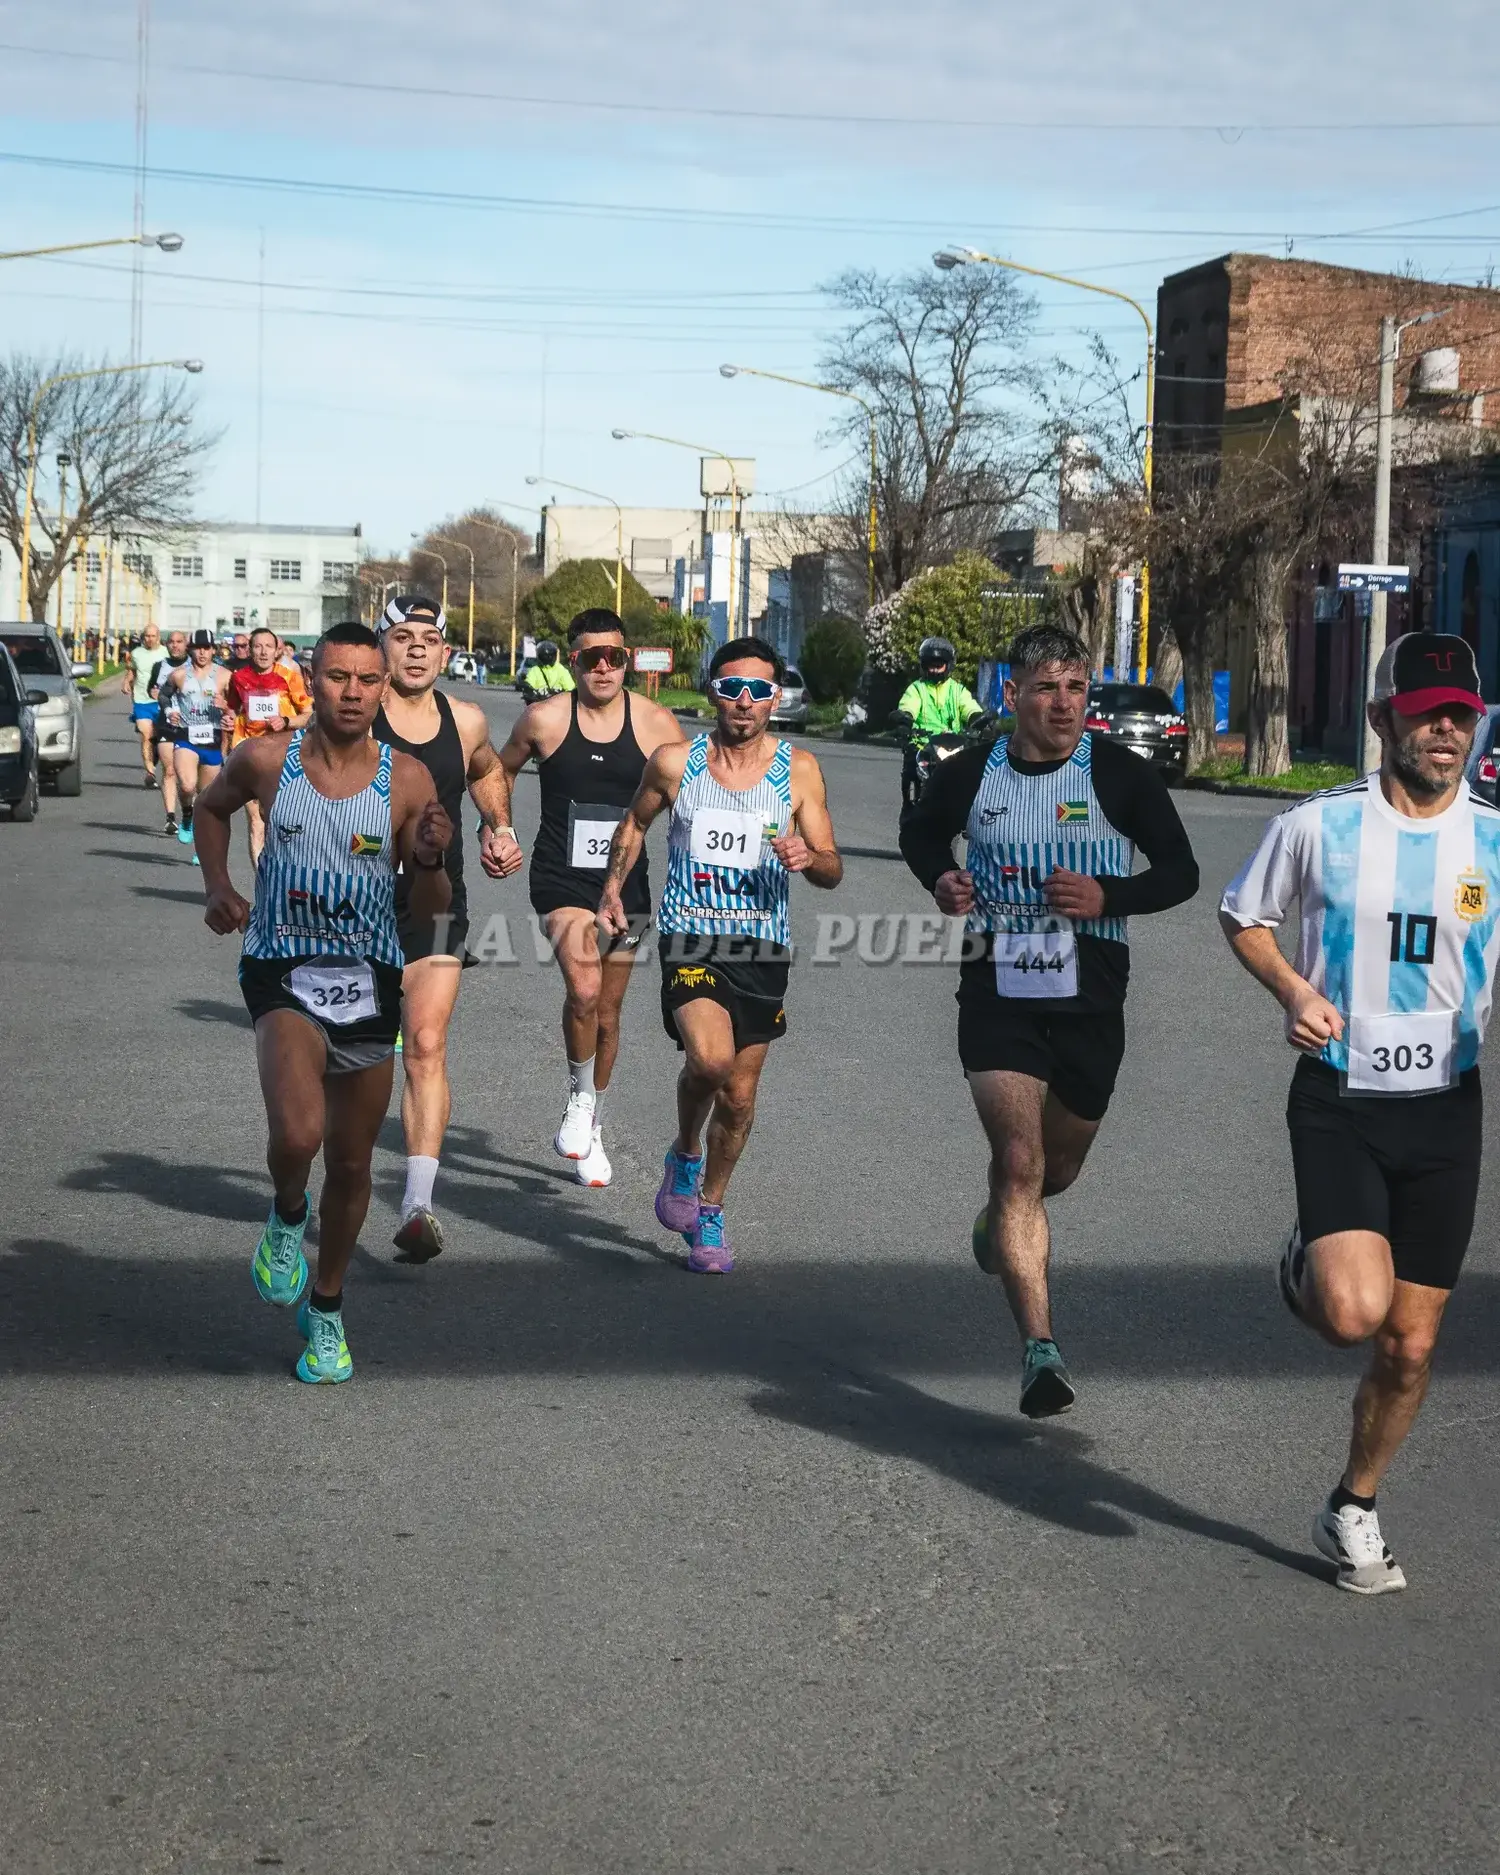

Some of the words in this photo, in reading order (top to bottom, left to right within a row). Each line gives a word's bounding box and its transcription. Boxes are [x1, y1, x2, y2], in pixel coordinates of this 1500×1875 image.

[255, 703, 274, 712] 306
[587, 838, 611, 856] 32
[706, 829, 746, 854] 301
[694, 872, 757, 896] FILA
[1000, 865, 1046, 889] FIL
[288, 889, 356, 920] FILA
[681, 904, 772, 921] CORRECAMINOS
[275, 923, 373, 945] CORRECANOS
[1387, 911, 1438, 965] 10
[1013, 950, 1065, 974] 444
[311, 981, 362, 1007] 325
[1371, 1043, 1434, 1073] 303
